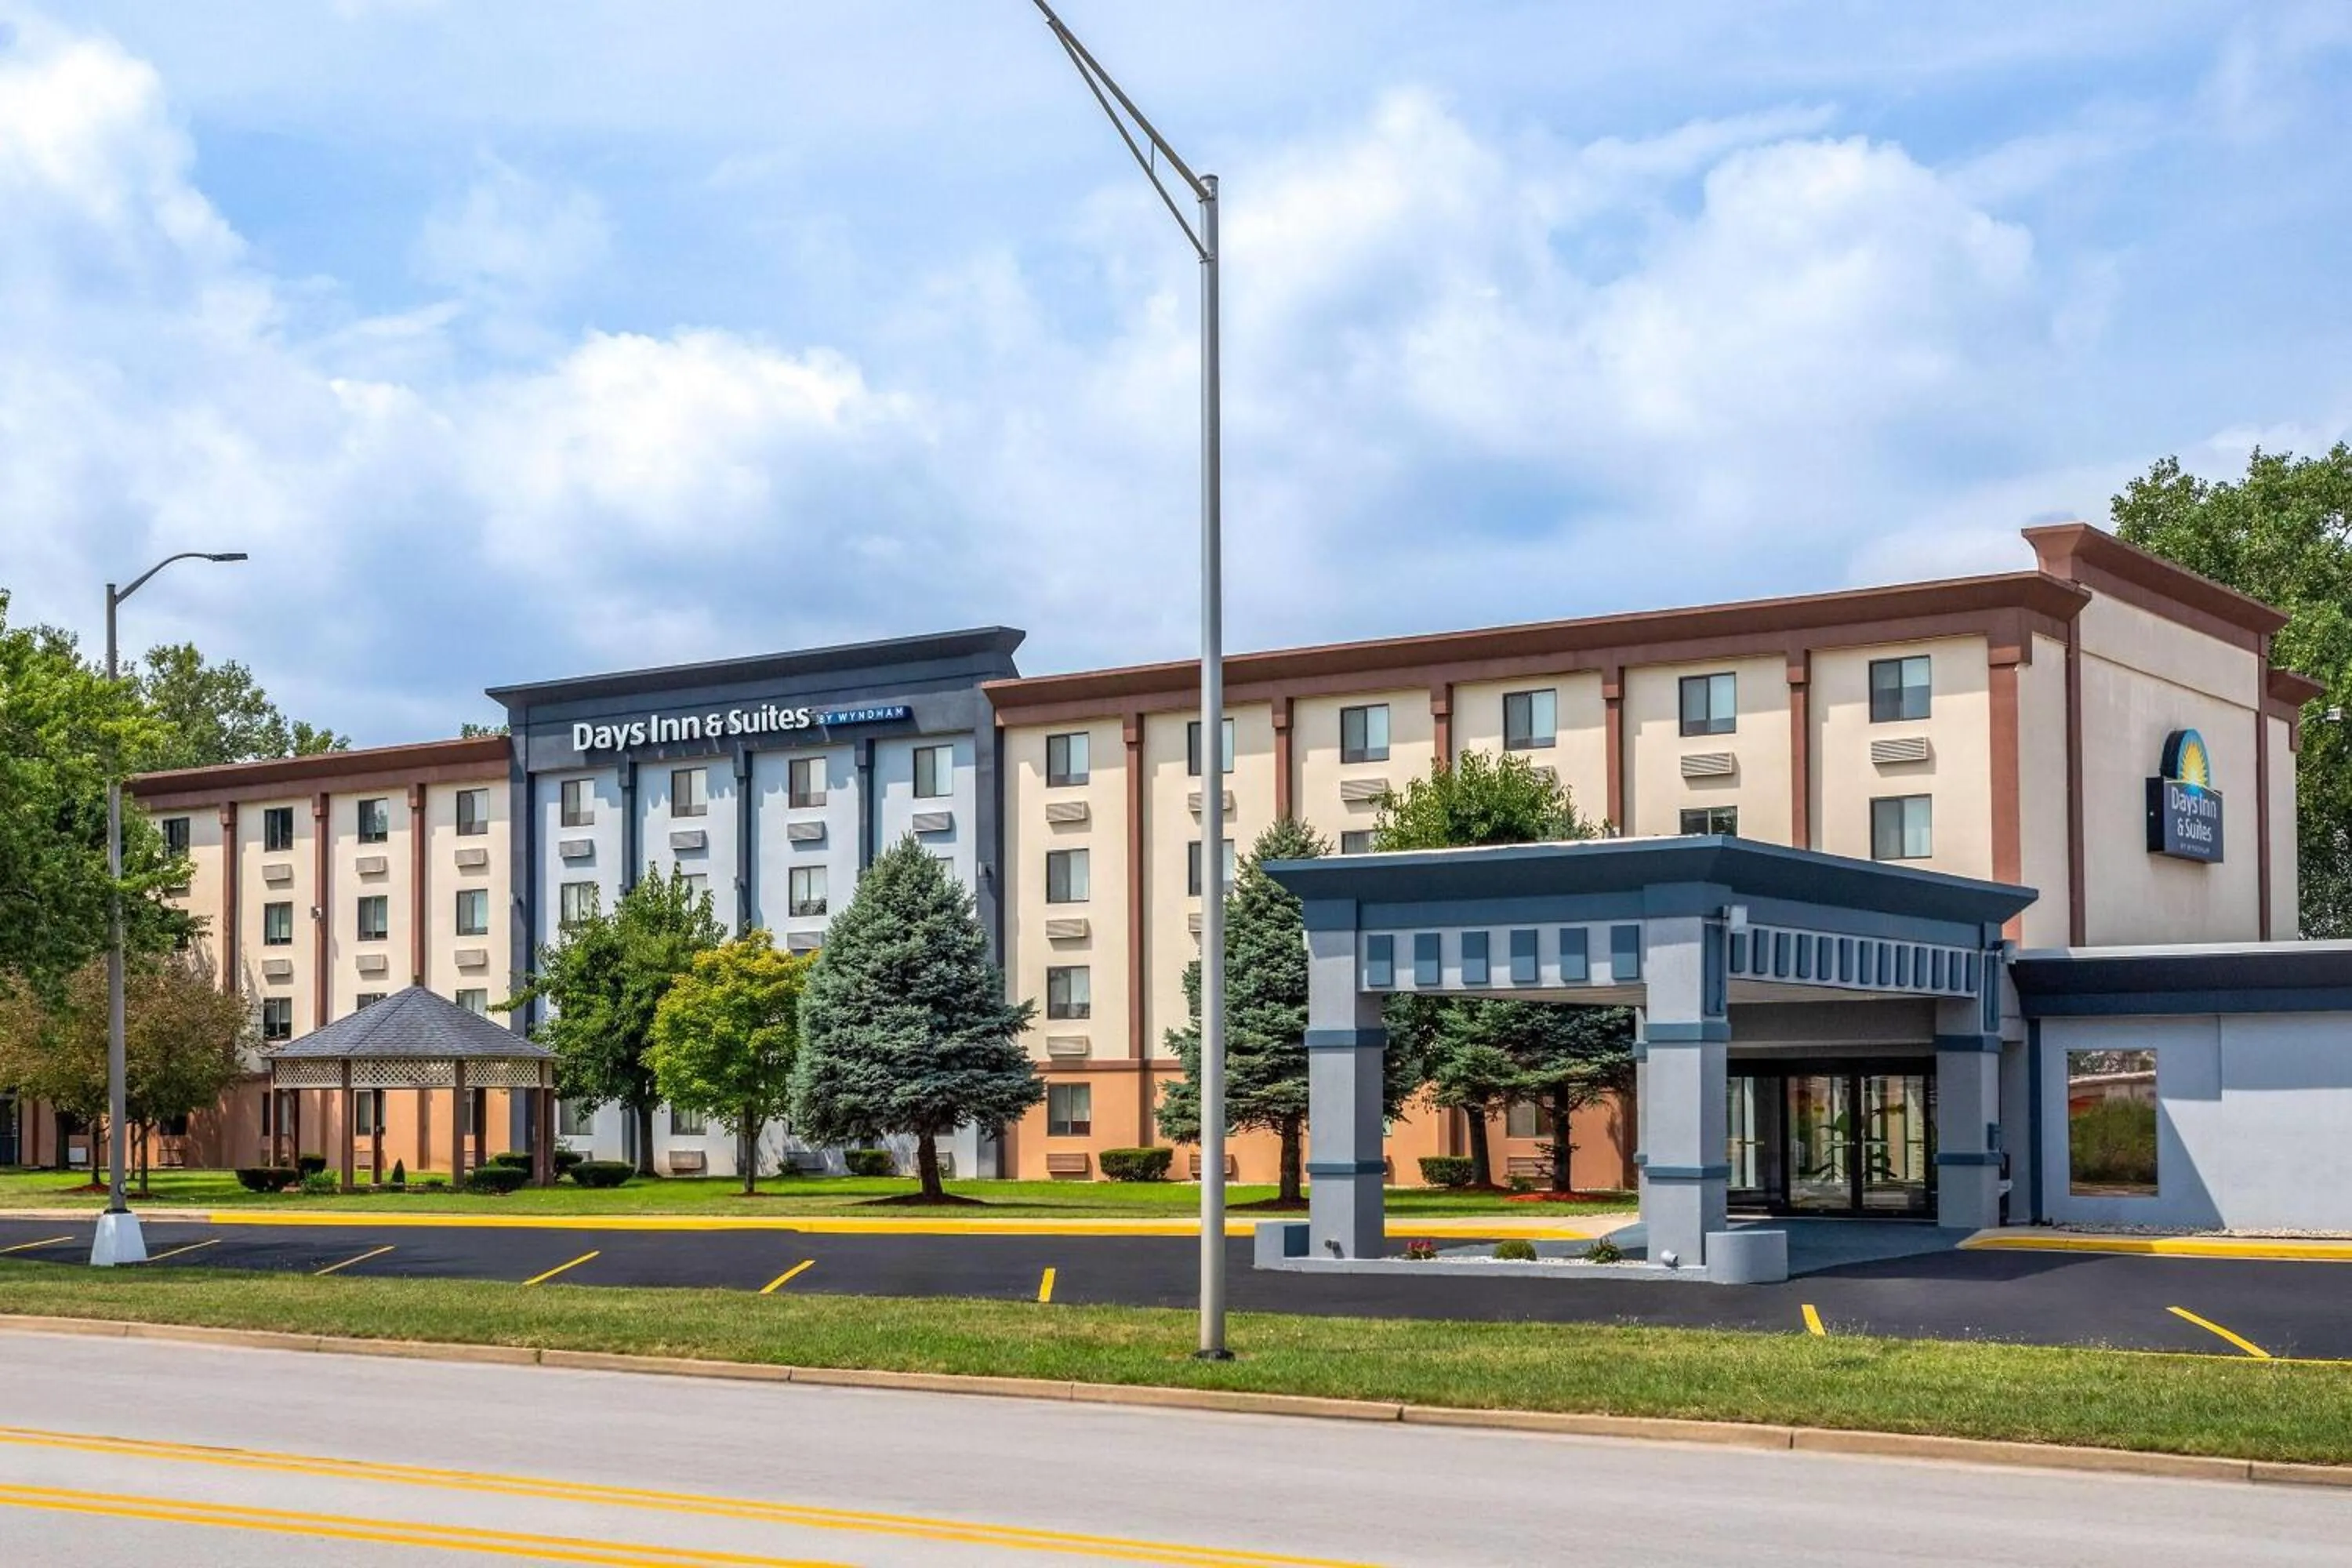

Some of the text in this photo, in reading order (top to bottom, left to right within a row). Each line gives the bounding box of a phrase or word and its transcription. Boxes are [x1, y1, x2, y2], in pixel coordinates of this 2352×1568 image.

[573, 704, 810, 752] Days Inn & Suites
[838, 706, 904, 722] WYNDHAM
[2171, 786, 2217, 819] Days Inn
[2177, 817, 2212, 844] & Suites
